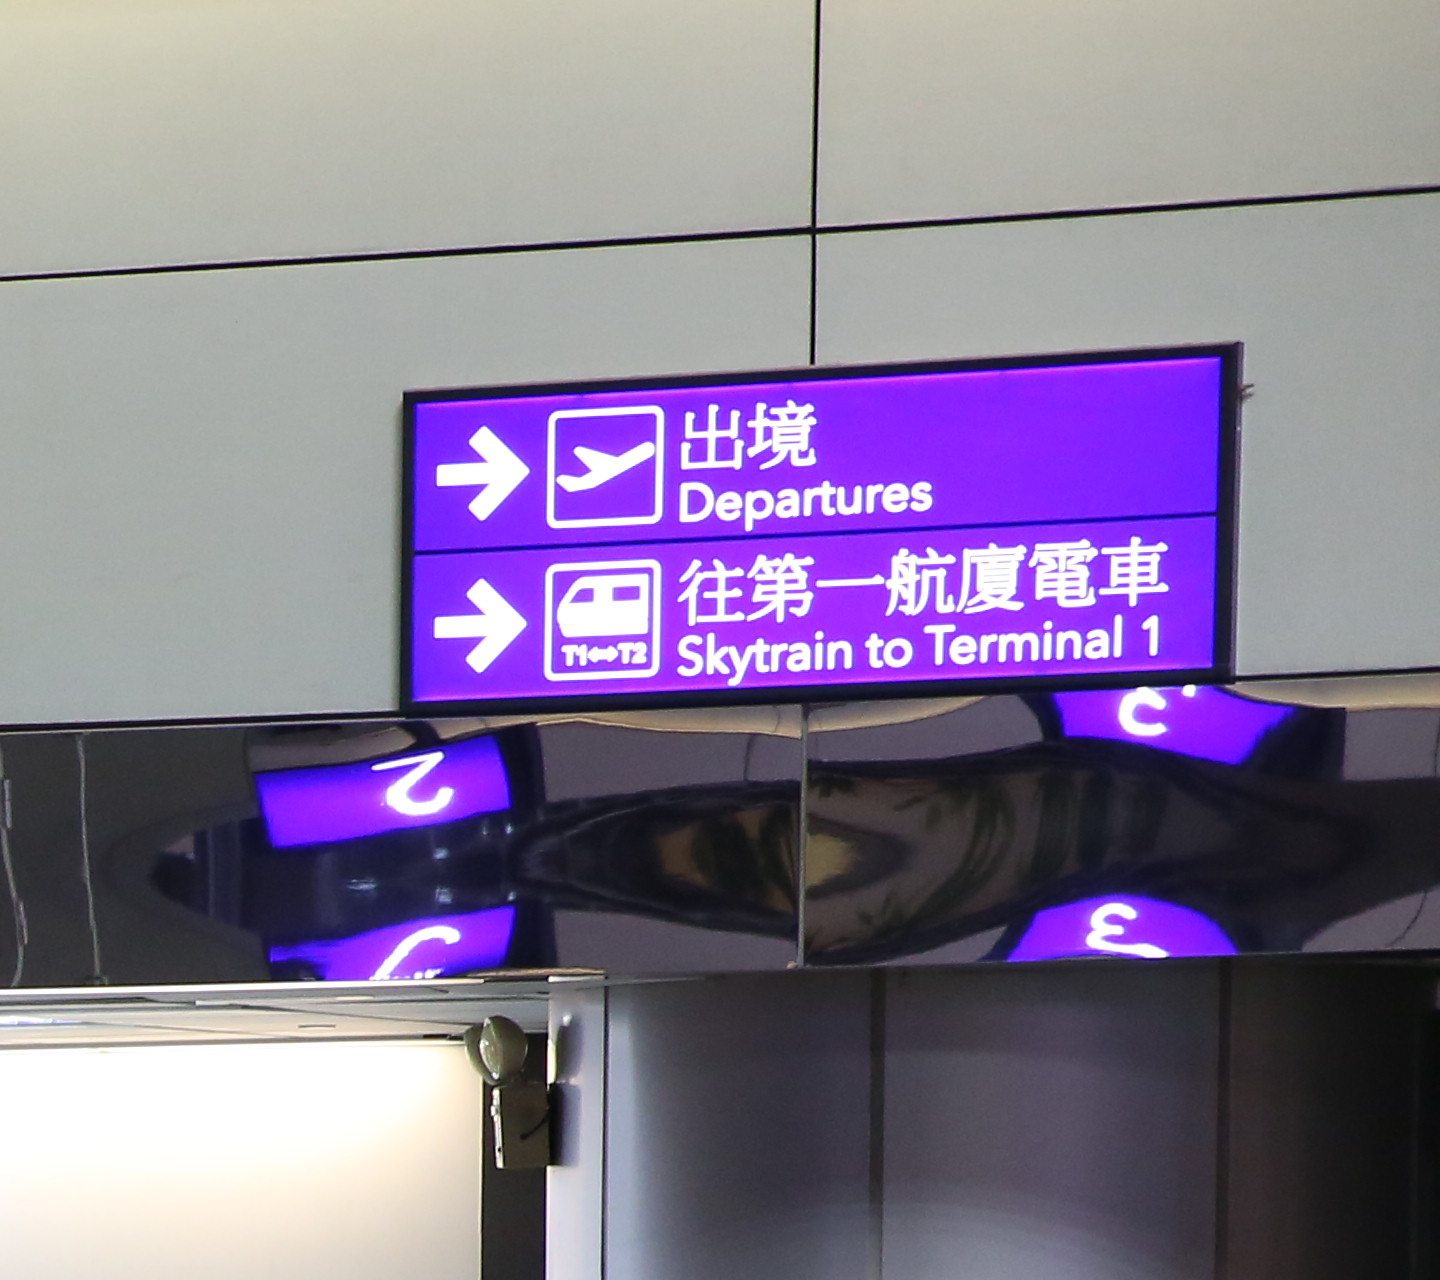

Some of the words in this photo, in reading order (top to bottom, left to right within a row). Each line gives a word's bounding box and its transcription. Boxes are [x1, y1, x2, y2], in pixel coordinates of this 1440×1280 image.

[680, 399, 818, 471] 出境
[679, 480, 933, 532] Departures
[561, 643, 588, 667] T1
[616, 641, 647, 665] T2
[677, 629, 853, 687] Skytrain
[866, 632, 915, 669] to
[924, 618, 1123, 664] Terminal
[1140, 615, 1160, 657] 1
